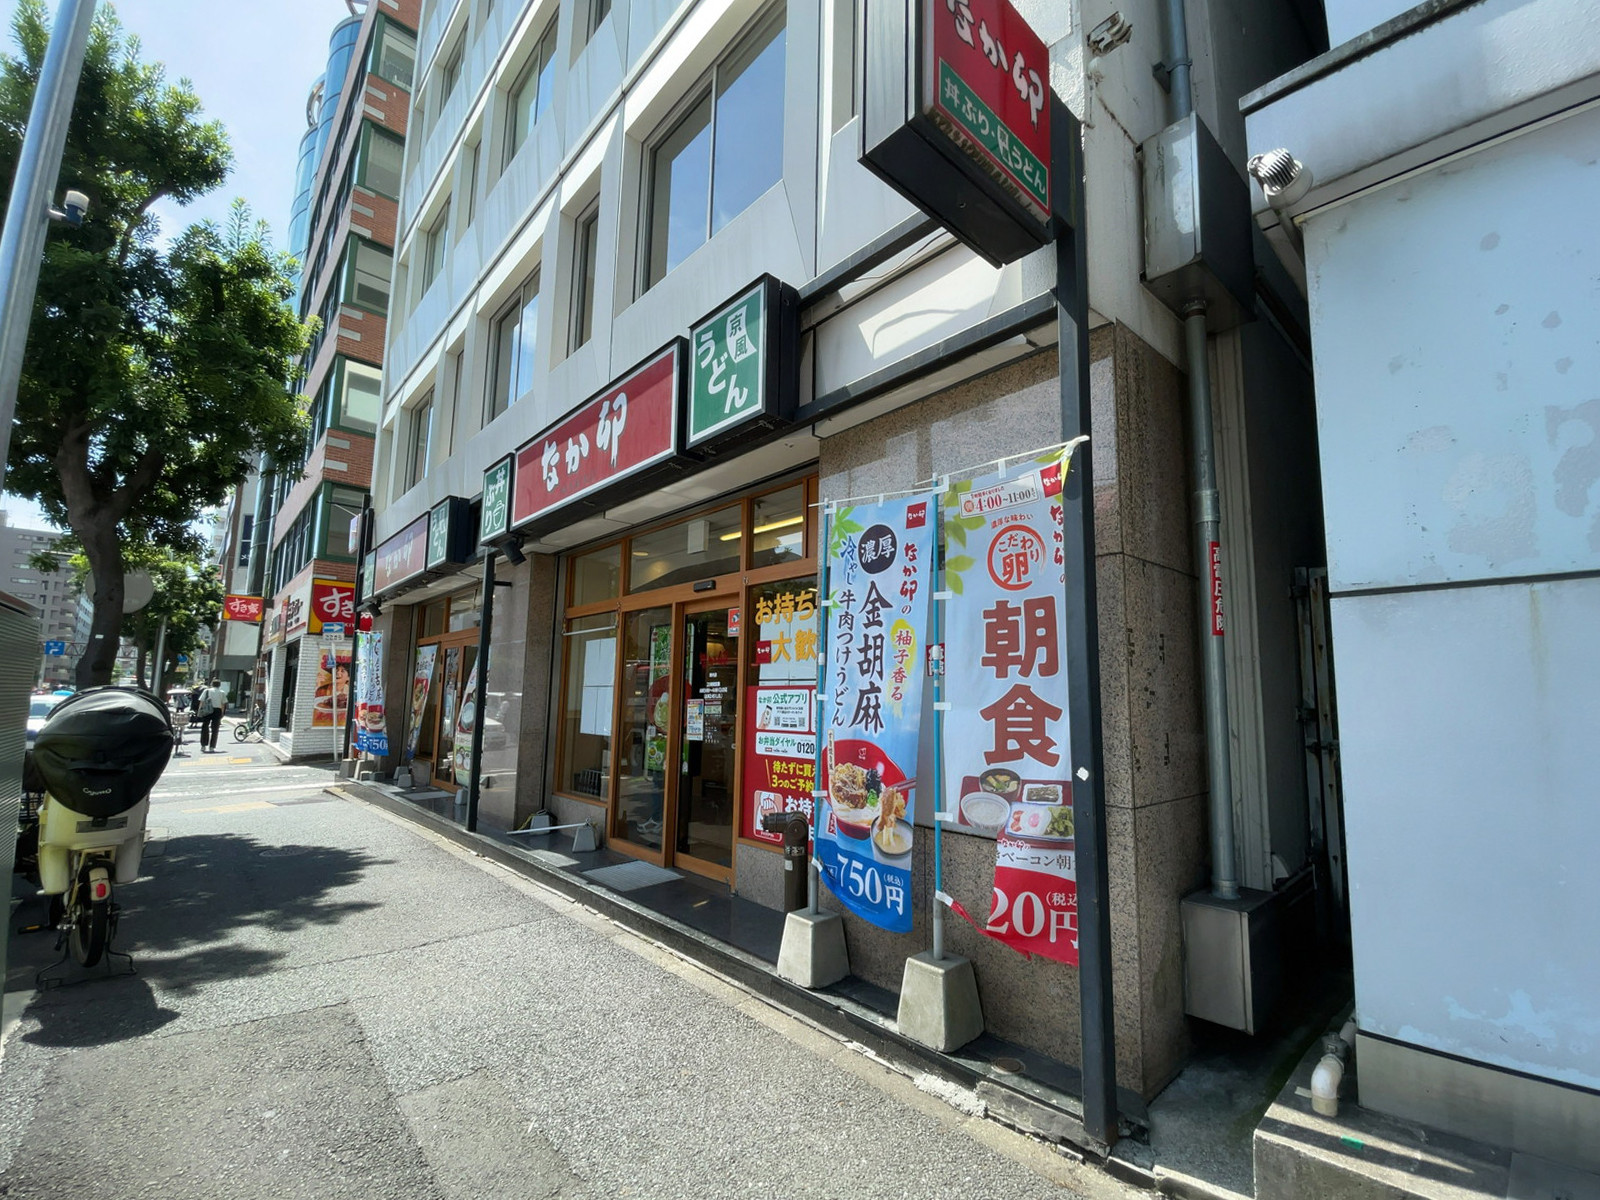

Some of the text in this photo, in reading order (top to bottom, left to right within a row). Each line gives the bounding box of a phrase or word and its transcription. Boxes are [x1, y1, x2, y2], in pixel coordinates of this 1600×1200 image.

[728, 312, 749, 362] 京風
[696, 329, 749, 414] うどん
[541, 391, 628, 493] なか卯
[860, 534, 895, 563] 濃厚
[900, 542, 918, 615] なか卯の
[998, 533, 1040, 563] こだわり
[1002, 551, 1029, 584] 卵
[849, 580, 894, 734] 金胡麻
[890, 629, 913, 702] 柚子香る
[980, 595, 1063, 768] 朝食
[797, 742, 815, 755] 0120
[996, 850, 1076, 871] ベーコン朝
